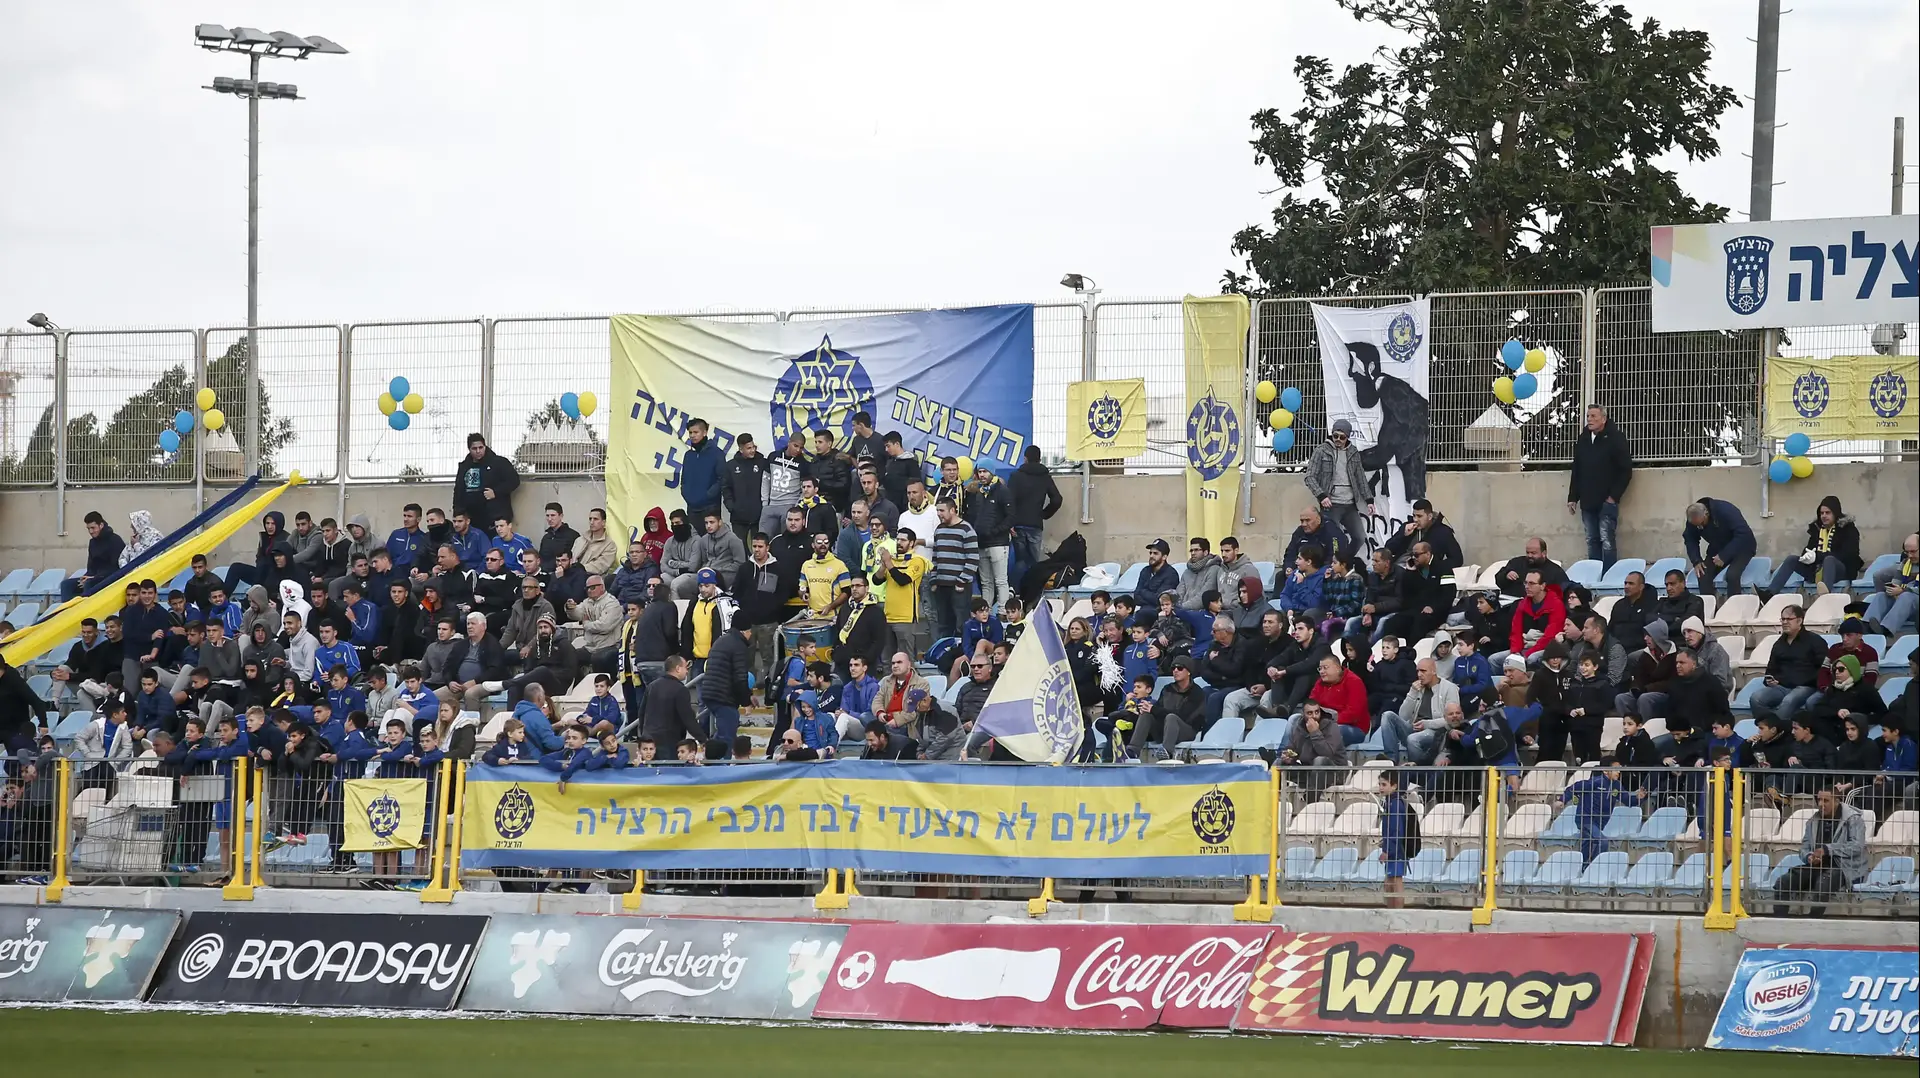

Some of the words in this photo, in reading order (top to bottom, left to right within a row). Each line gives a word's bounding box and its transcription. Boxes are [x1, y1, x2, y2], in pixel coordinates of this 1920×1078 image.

[1726, 238, 1770, 253] הרצליה
[891, 386, 1025, 467] הקבוצה
[575, 798, 693, 835] הרצליה
[706, 803, 785, 833] מכבי
[799, 794, 862, 833] לבד
[878, 805, 980, 839] תצעדי
[994, 801, 1038, 841] לא
[1050, 801, 1151, 845] לעולם
[495, 840, 523, 848] הרצליה
[1200, 846, 1230, 854] הרצליה
[227, 939, 471, 991] BROADSAY
[598, 928, 749, 996] Carlsberg
[1065, 936, 1263, 1012] Coca-Cola
[1767, 964, 1801, 980] גלידות
[1734, 1025, 1760, 1037] Makes
[1761, 1029, 1777, 1037] me
